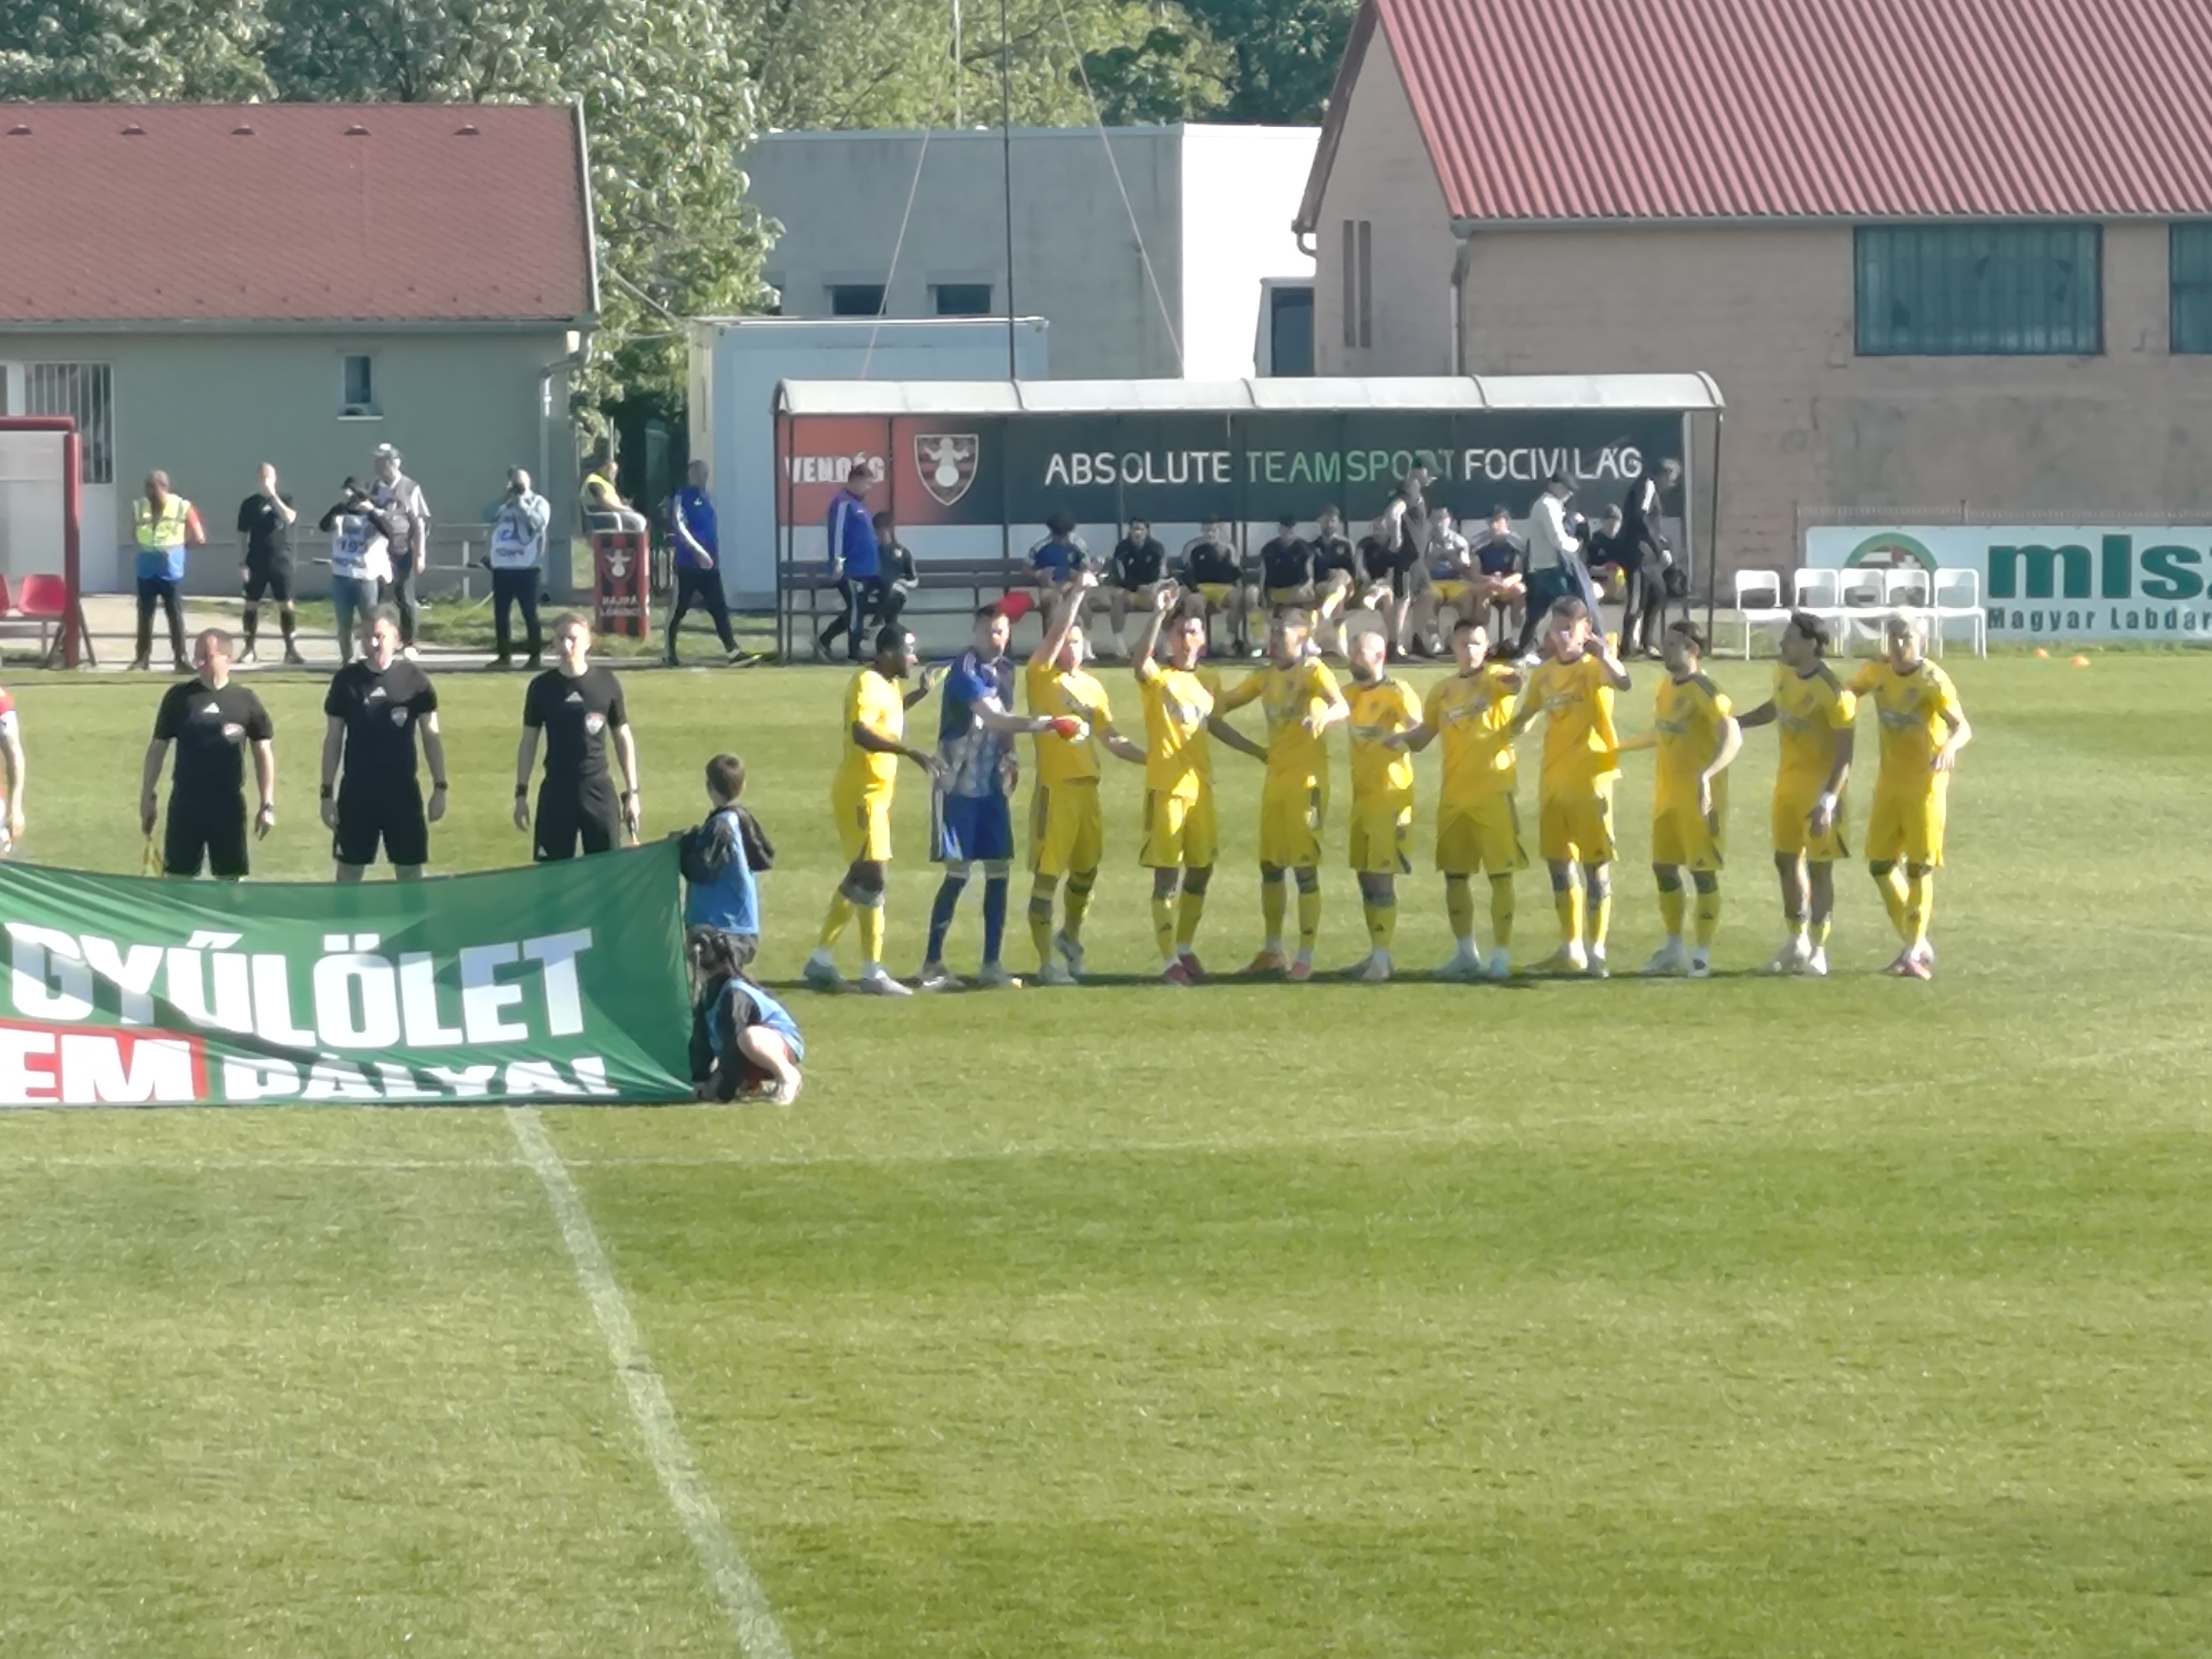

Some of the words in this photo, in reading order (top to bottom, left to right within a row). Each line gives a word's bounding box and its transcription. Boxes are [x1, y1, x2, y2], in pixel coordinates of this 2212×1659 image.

[1045, 450, 1232, 486] ABSOLUTE
[1987, 534, 2212, 601] mls
[1988, 606, 2096, 632] Magyar
[3, 922, 593, 1048] GYŰLÖLET
